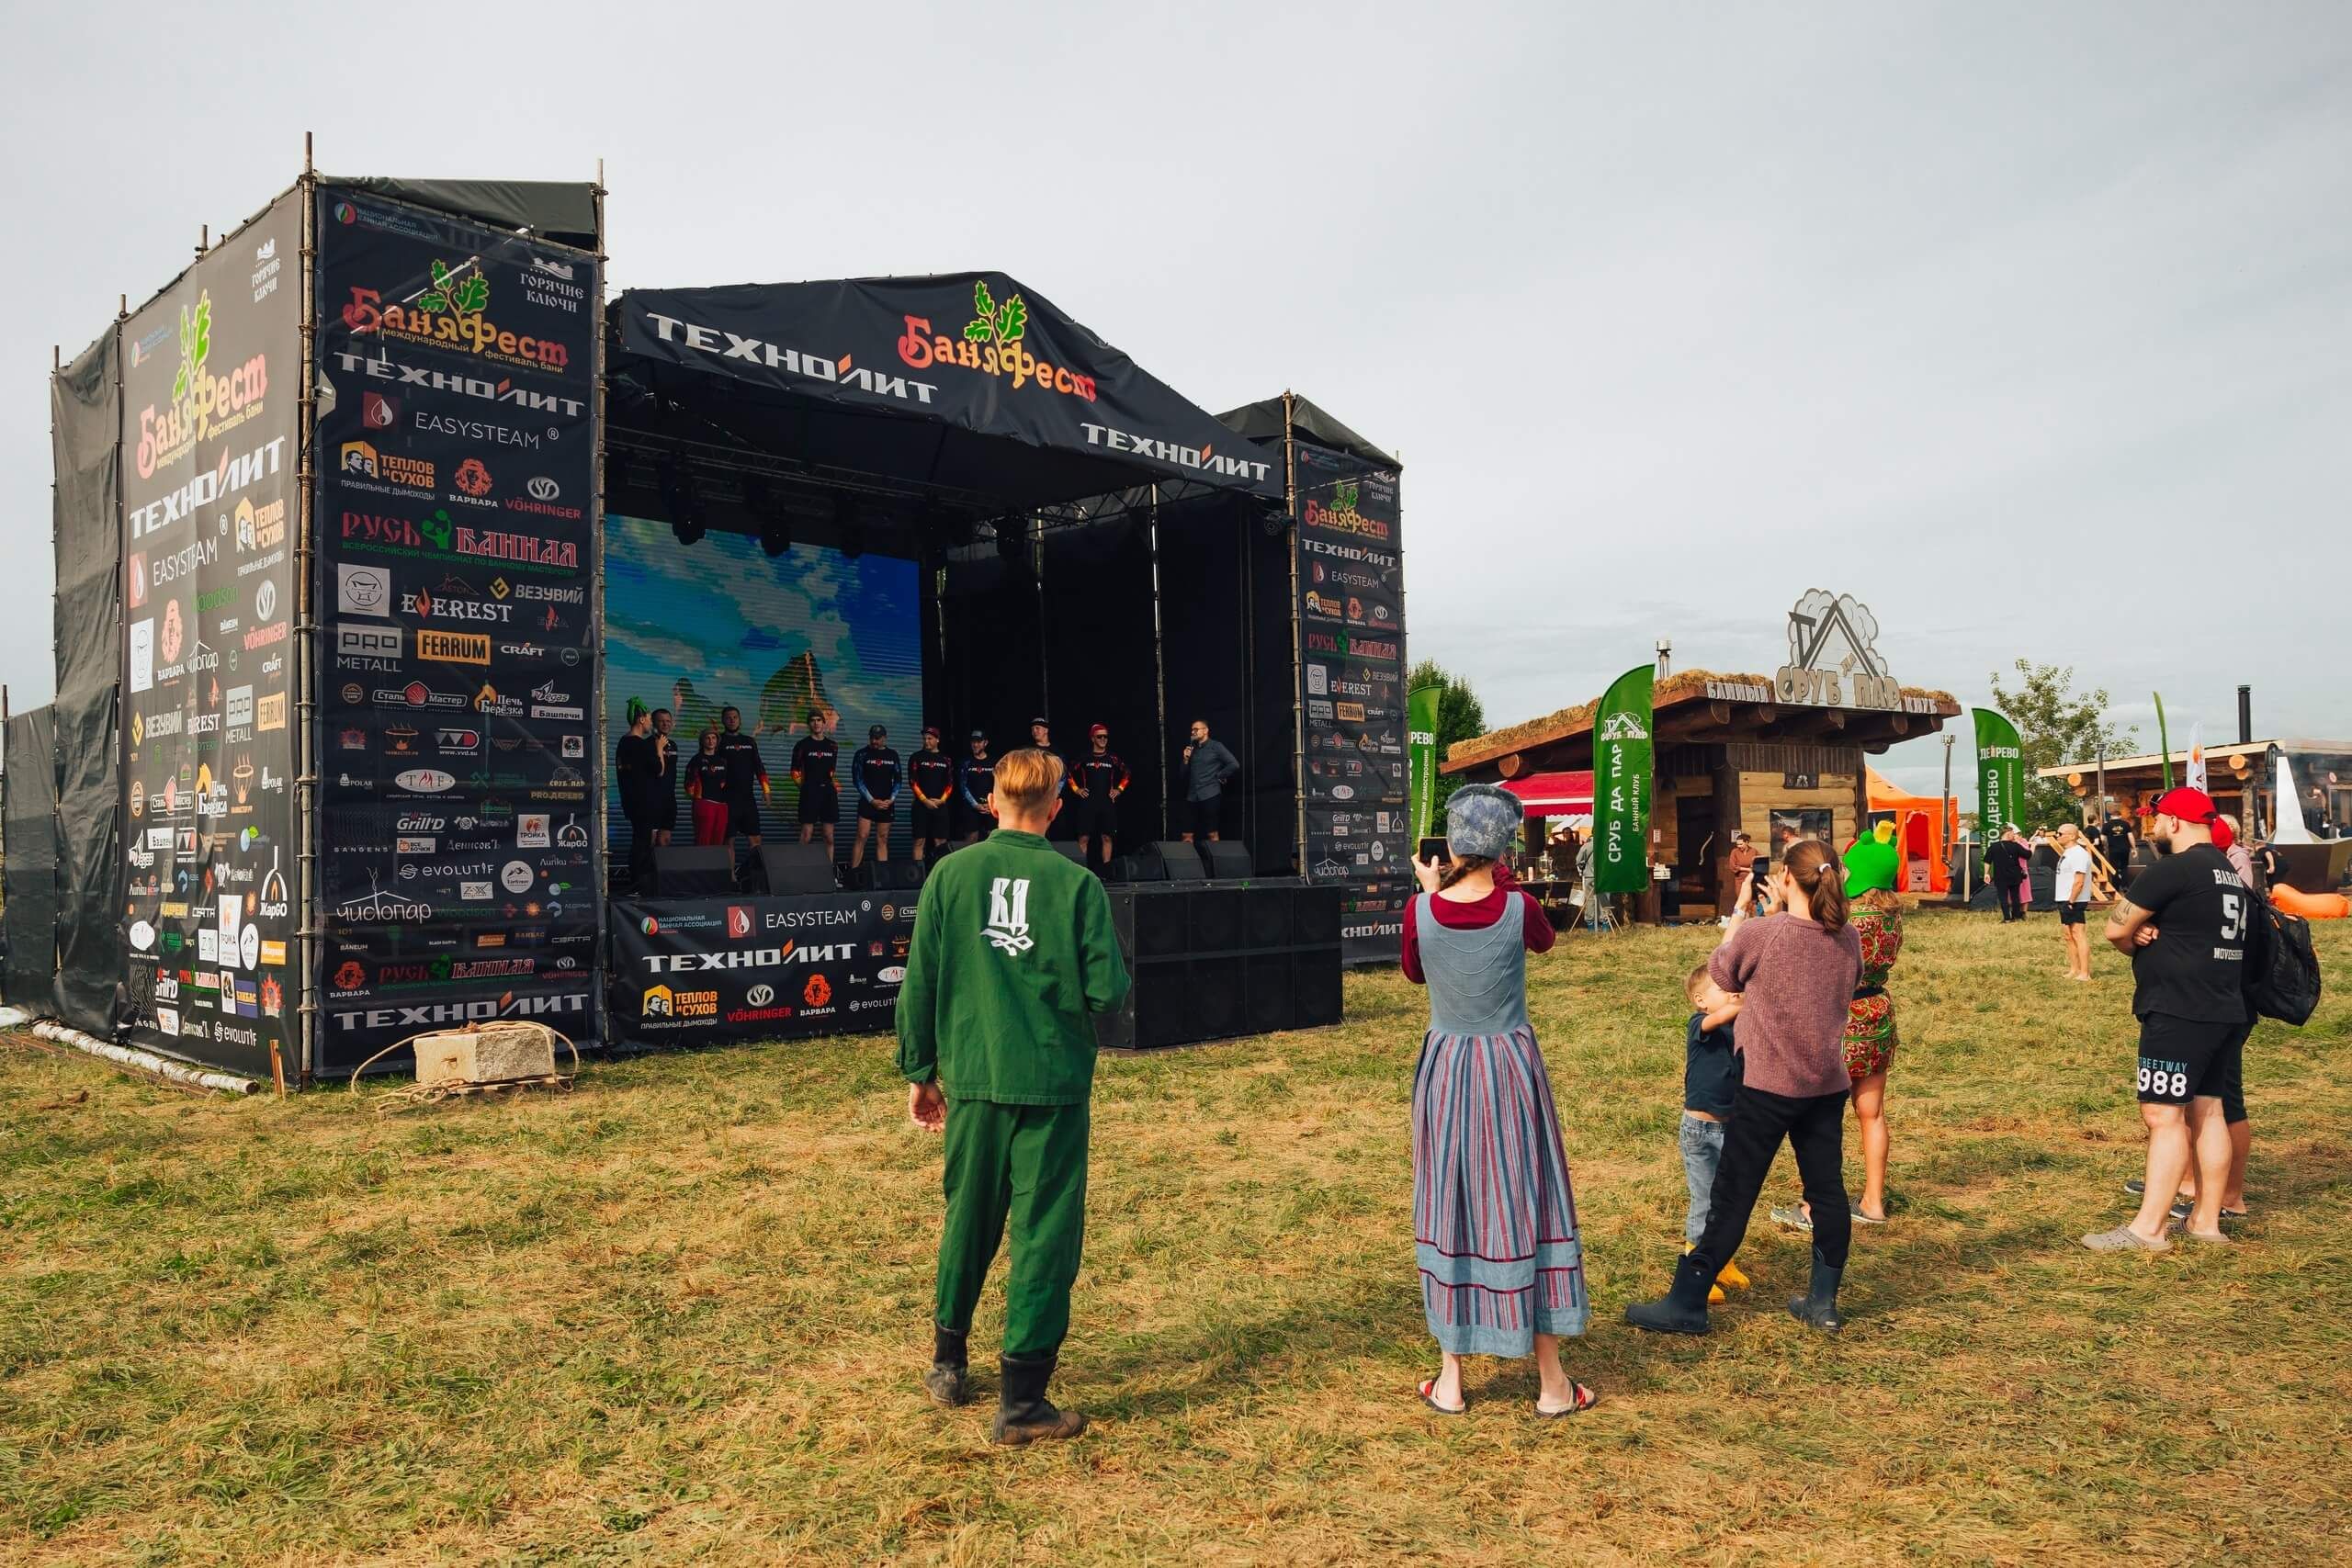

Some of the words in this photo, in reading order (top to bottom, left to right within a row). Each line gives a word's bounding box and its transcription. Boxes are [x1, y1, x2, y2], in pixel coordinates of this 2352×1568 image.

[526, 289, 578, 313] КЛЮЧИ
[381, 328, 469, 354] международный
[484, 349, 537, 369] фестиваль
[647, 312, 938, 403] ТЕХНОЛИТ
[333, 352, 585, 417] ТЕХНОЛИТ
[415, 412, 539, 449] EASYSTEAM
[1080, 423, 1271, 481] ТЕХНОЛИТ
[380, 455, 435, 475] ТЕПЛОВ
[130, 435, 286, 539] ТЕХНОЛИТ
[341, 479, 390, 494] ПРАВИЛЬНЫЕ
[391, 486, 435, 501] ДЫМОХОДЫ
[390, 469, 435, 488] СУХОВ
[448, 493, 498, 508] ВАРВАРА
[505, 497, 582, 520] VÖHRINGER
[341, 511, 421, 547] РУСЬ
[456, 526, 579, 568] БАННАЯ
[153, 536, 219, 587] EASYSTEAM
[1302, 539, 1396, 567] ТЕХНОЛИТ
[1332, 570, 1379, 589] EASYSTEAM
[515, 583, 584, 605] ВЕЗУВИЙ
[423, 634, 486, 660] FERRUM
[337, 656, 402, 673] METALL
[429, 694, 462, 705] Мастер
[1775, 666, 1841, 705] СРУБ
[1852, 672, 1901, 710] ПАР
[145, 704, 183, 739] ВЕЗУВИЙ
[538, 710, 581, 720] Башпечи
[225, 727, 253, 744] METALL
[1611, 743, 1623, 778] ПАР
[1632, 773, 1640, 795] КЛУБ
[1611, 785, 1624, 812] ДА
[1632, 795, 1640, 832] БАННЫЙ
[1608, 819, 1622, 863] СРУБ
[766, 909, 856, 929] EASYSTEAM
[642, 939, 857, 973] ТЕХНОЛИТ
[674, 990, 718, 1004] ТЕПЛОВ
[334, 991, 588, 1030] ТЕХНОЛИТ
[683, 1002, 718, 1017] СУХОВ
[727, 1005, 792, 1022] VÖHRINGER
[800, 1007, 836, 1017] ВАРВАРА
[641, 1020, 683, 1030] ПРАВИЛЬНЫЕ
[683, 1018, 718, 1028] ДЫМОХОДЫ
